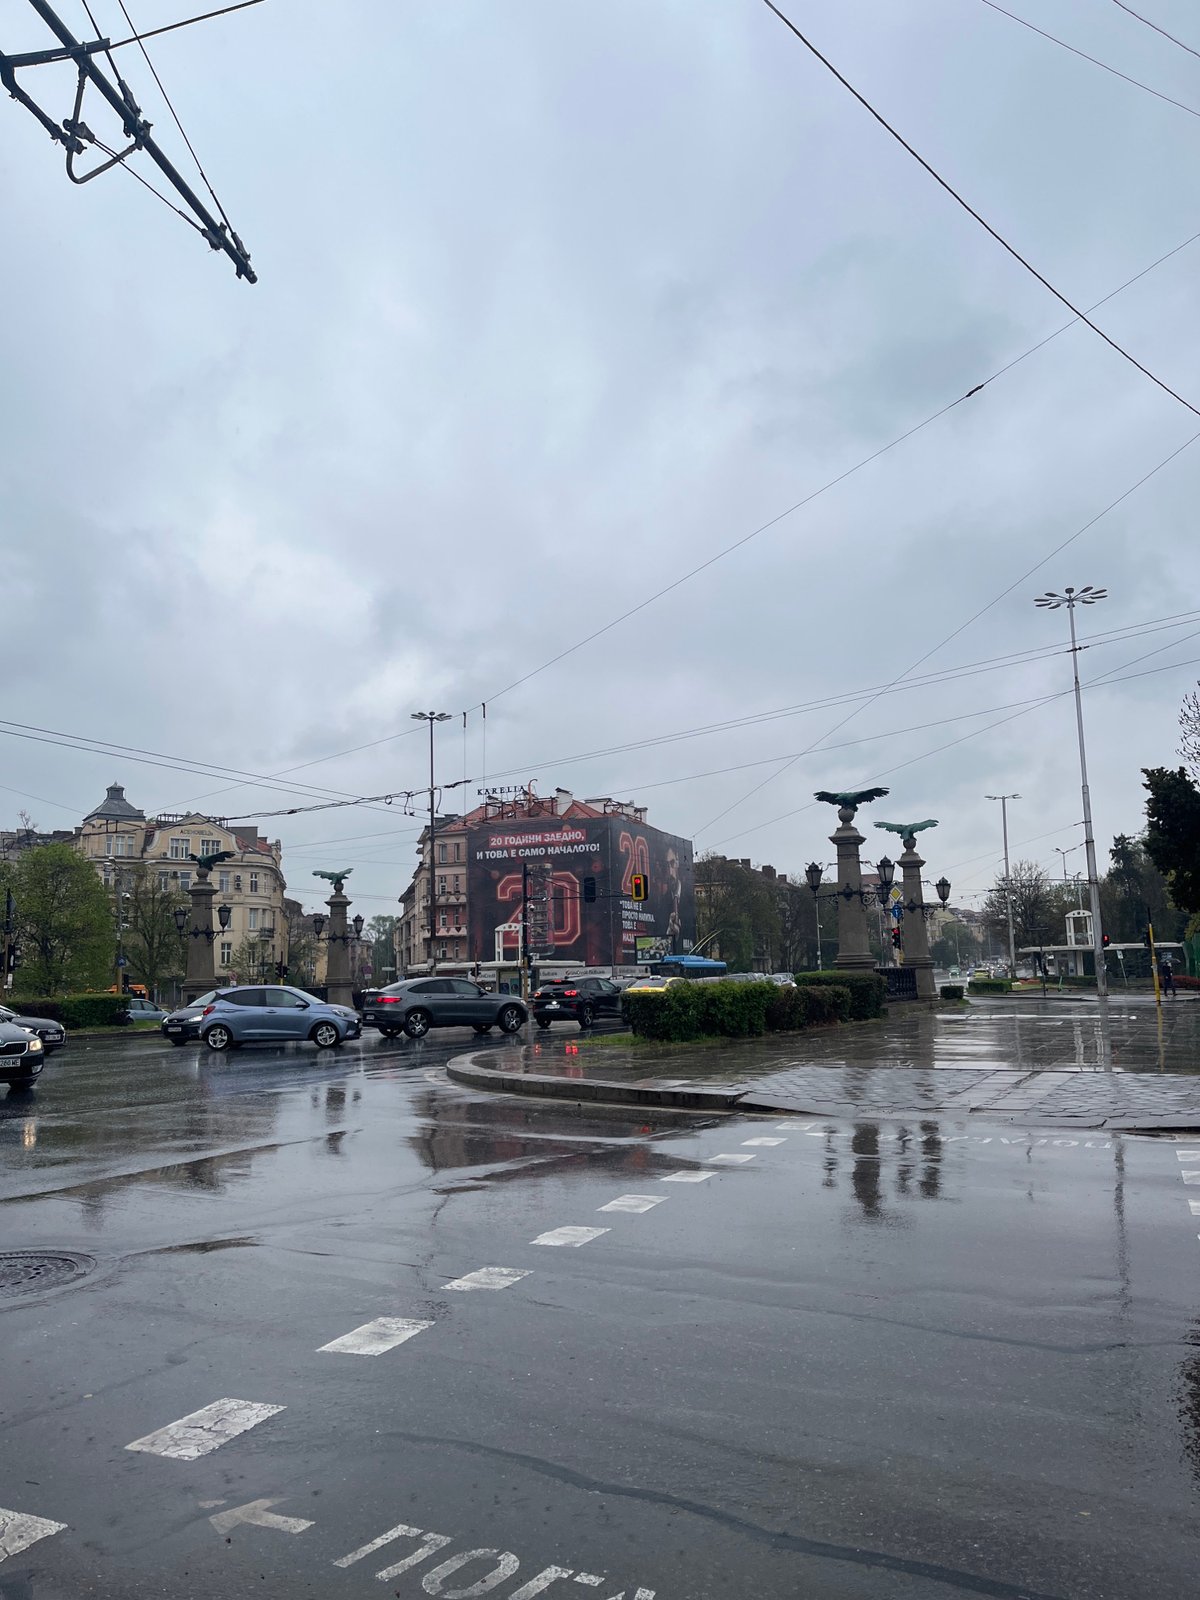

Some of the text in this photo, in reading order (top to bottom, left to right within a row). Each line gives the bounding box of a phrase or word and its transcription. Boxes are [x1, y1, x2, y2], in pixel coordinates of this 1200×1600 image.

[477, 785, 524, 796] KARELIA
[490, 831, 585, 846] 20 ГОДИНИ ЗАЕДНО,
[476, 843, 600, 860] И ТОВА Е САМО НАЧАЛОТО!
[618, 831, 651, 896] 20
